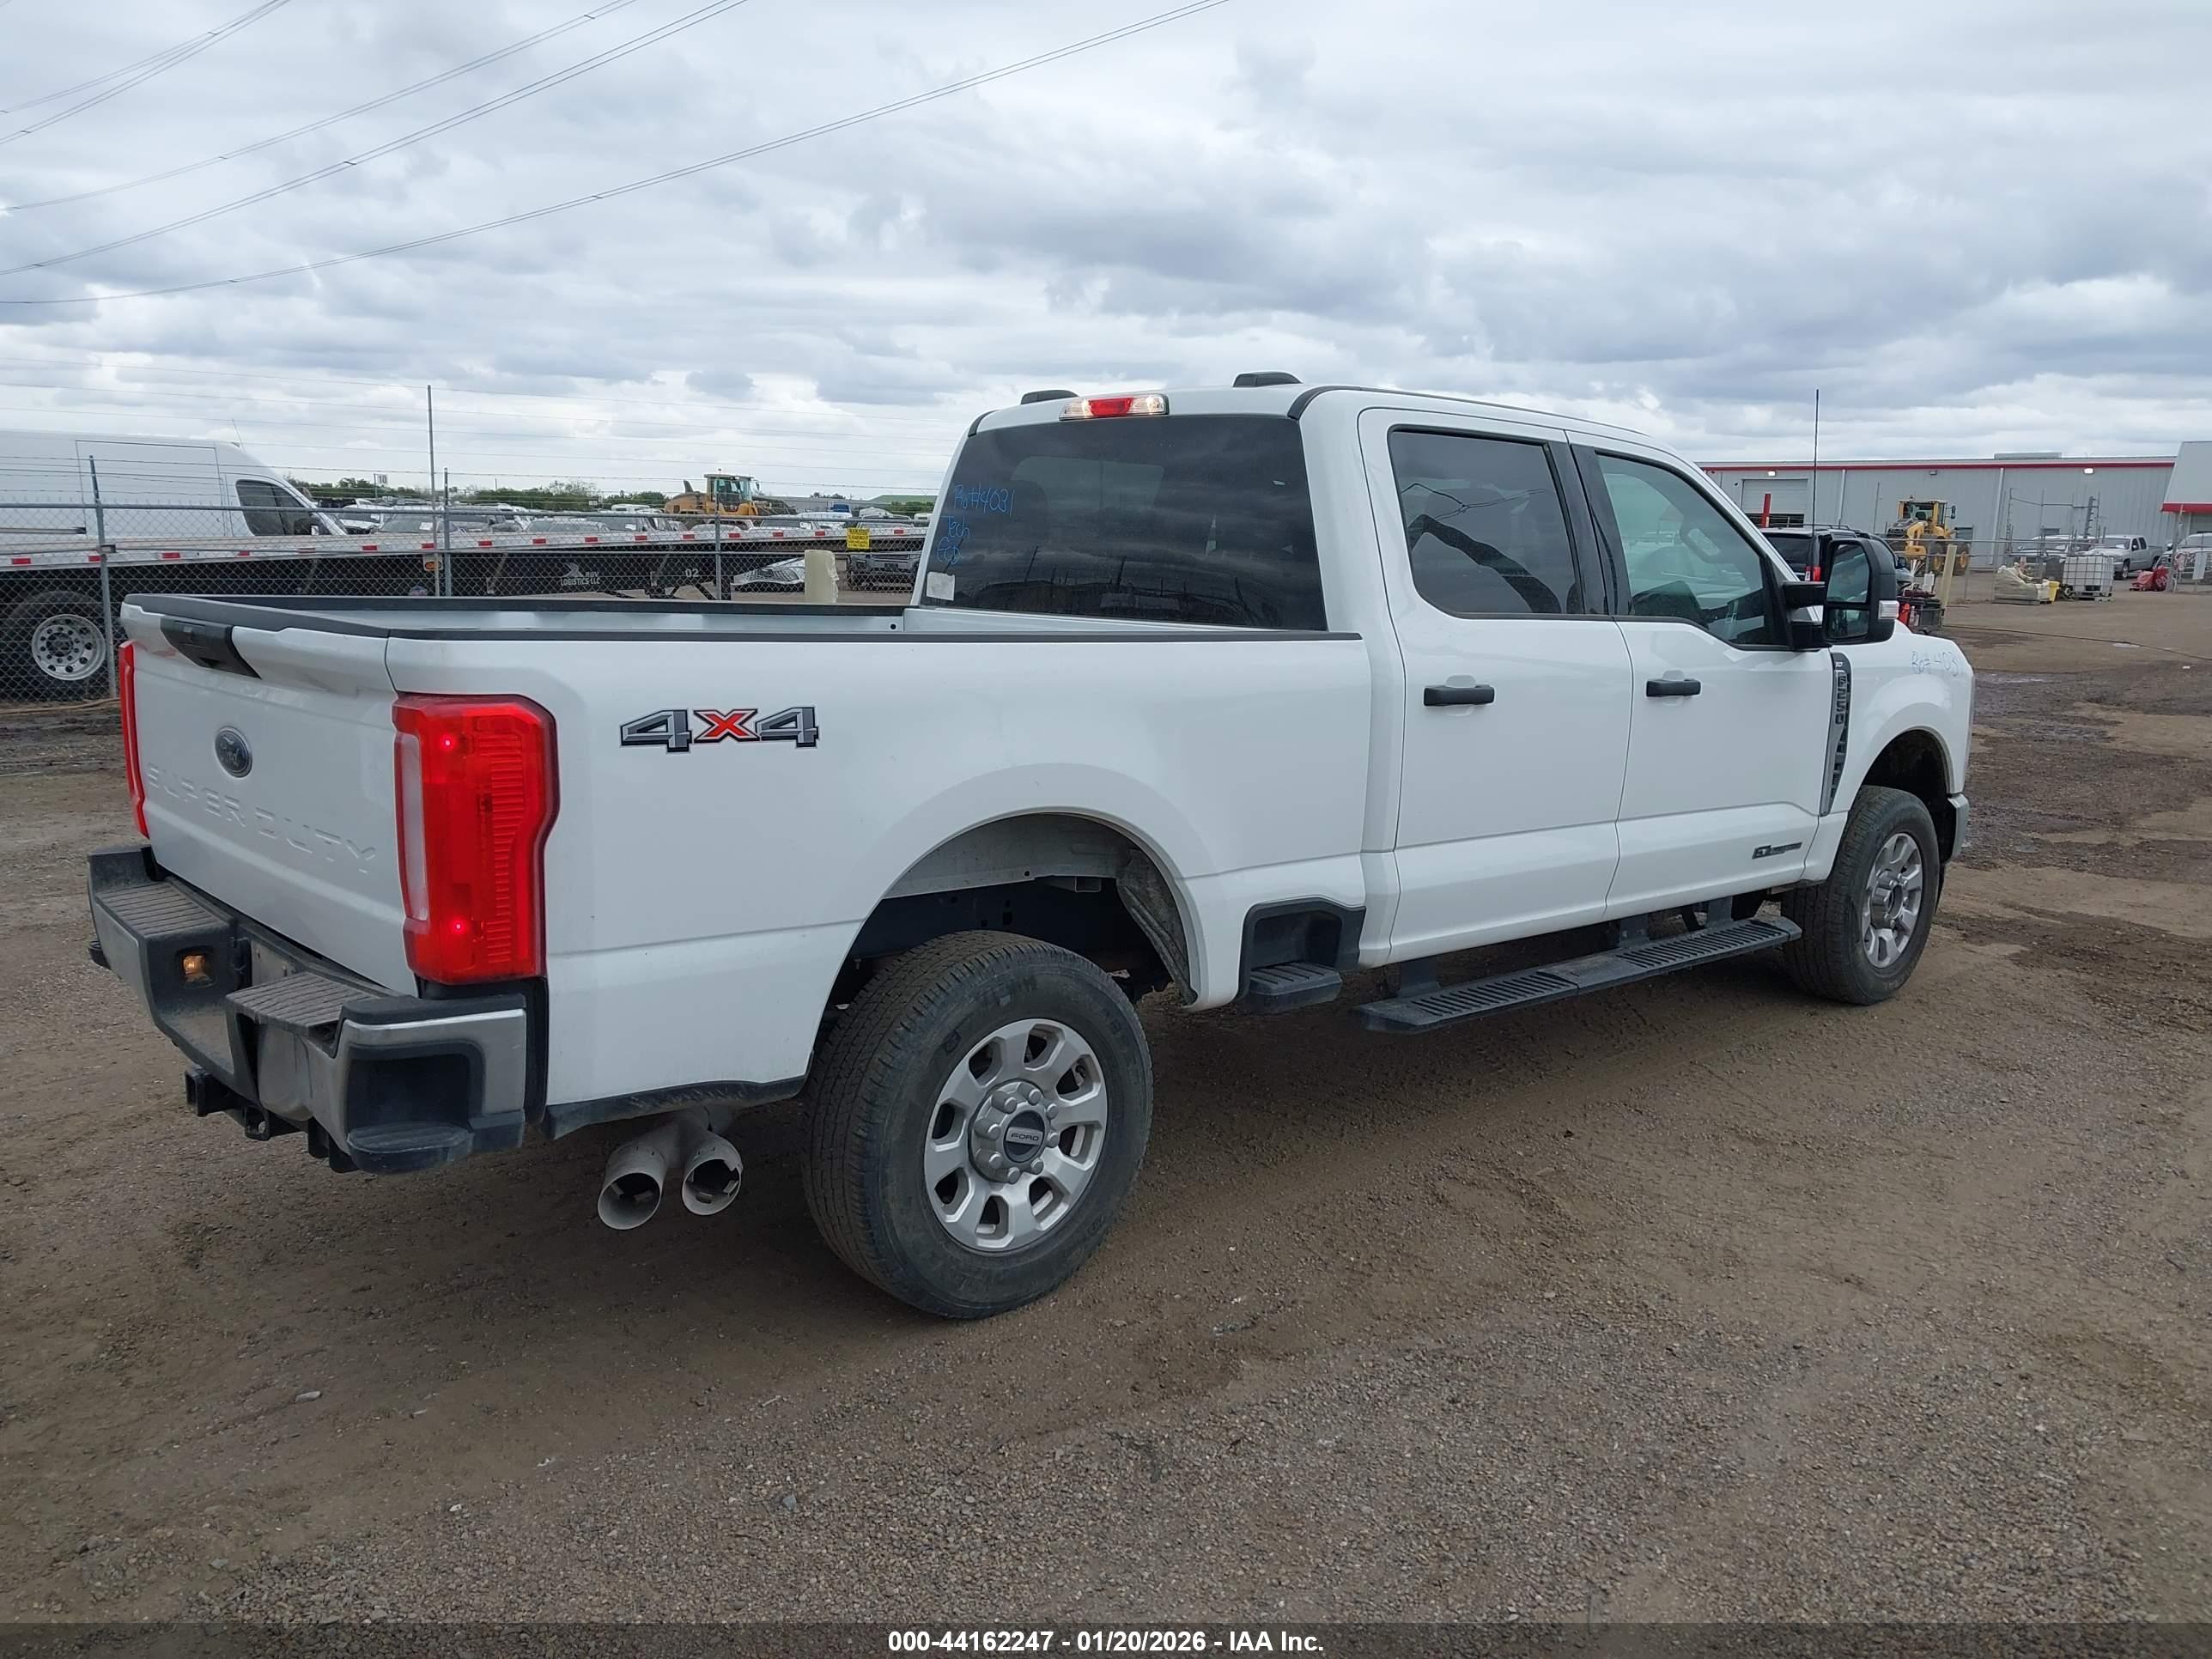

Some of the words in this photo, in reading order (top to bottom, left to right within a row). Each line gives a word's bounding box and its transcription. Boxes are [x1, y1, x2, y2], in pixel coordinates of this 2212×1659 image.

[684, 568, 700, 578] 02
[148, 763, 246, 829] SUPER
[255, 807, 376, 874] DUTY
[1011, 1133, 1039, 1142] FORD
